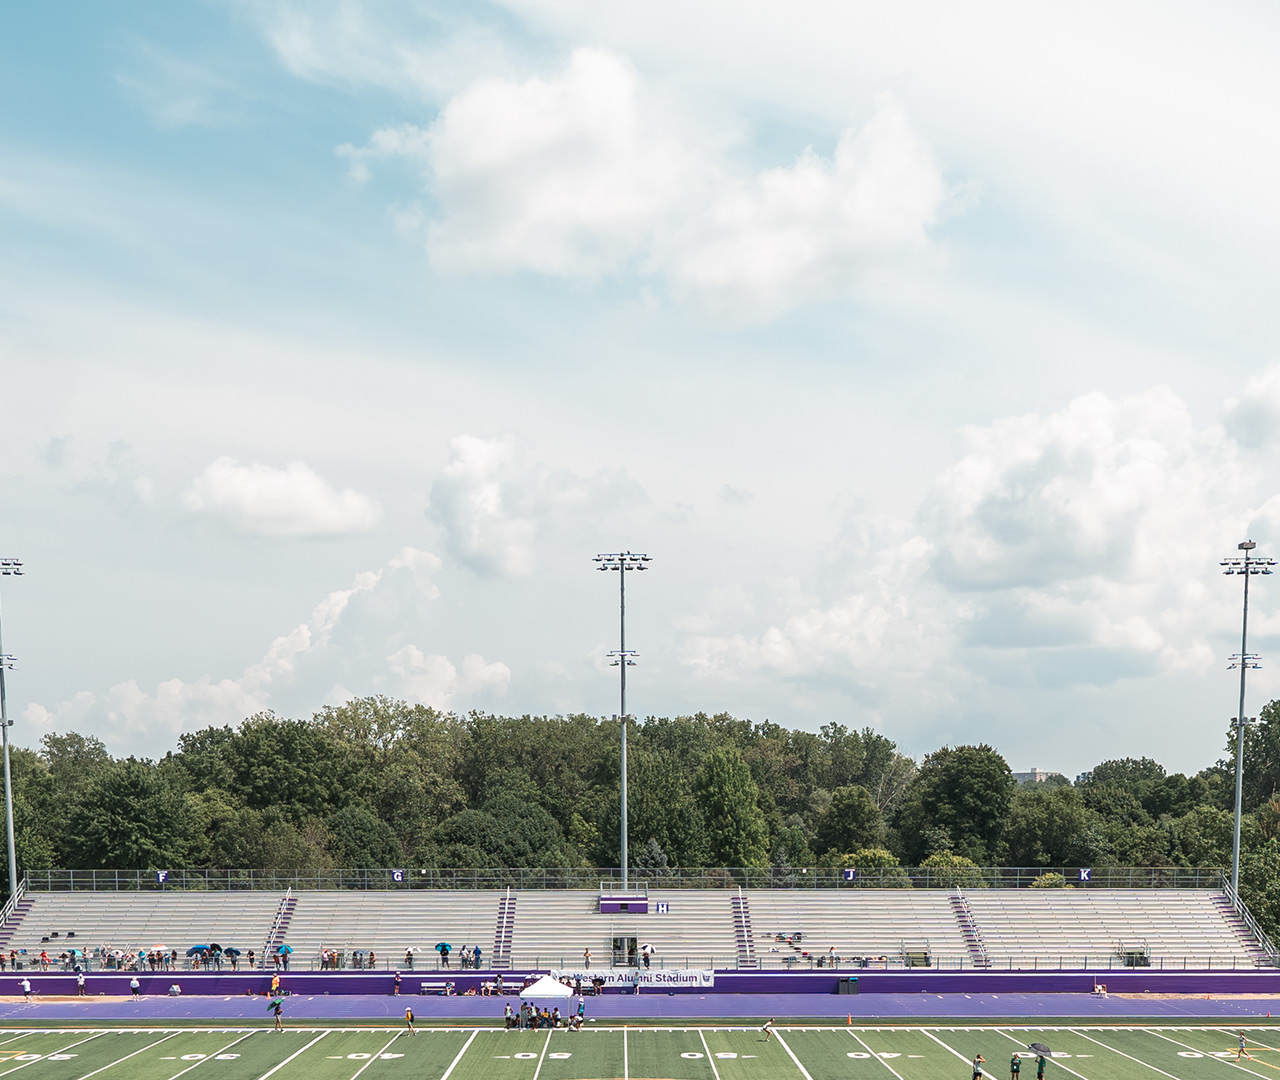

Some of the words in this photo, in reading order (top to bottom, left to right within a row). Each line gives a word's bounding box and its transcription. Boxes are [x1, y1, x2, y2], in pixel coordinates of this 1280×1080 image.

[159, 873, 166, 882] F
[393, 872, 402, 881] G
[1081, 871, 1089, 880] K
[658, 904, 667, 913] H
[656, 973, 697, 983] Stadium
